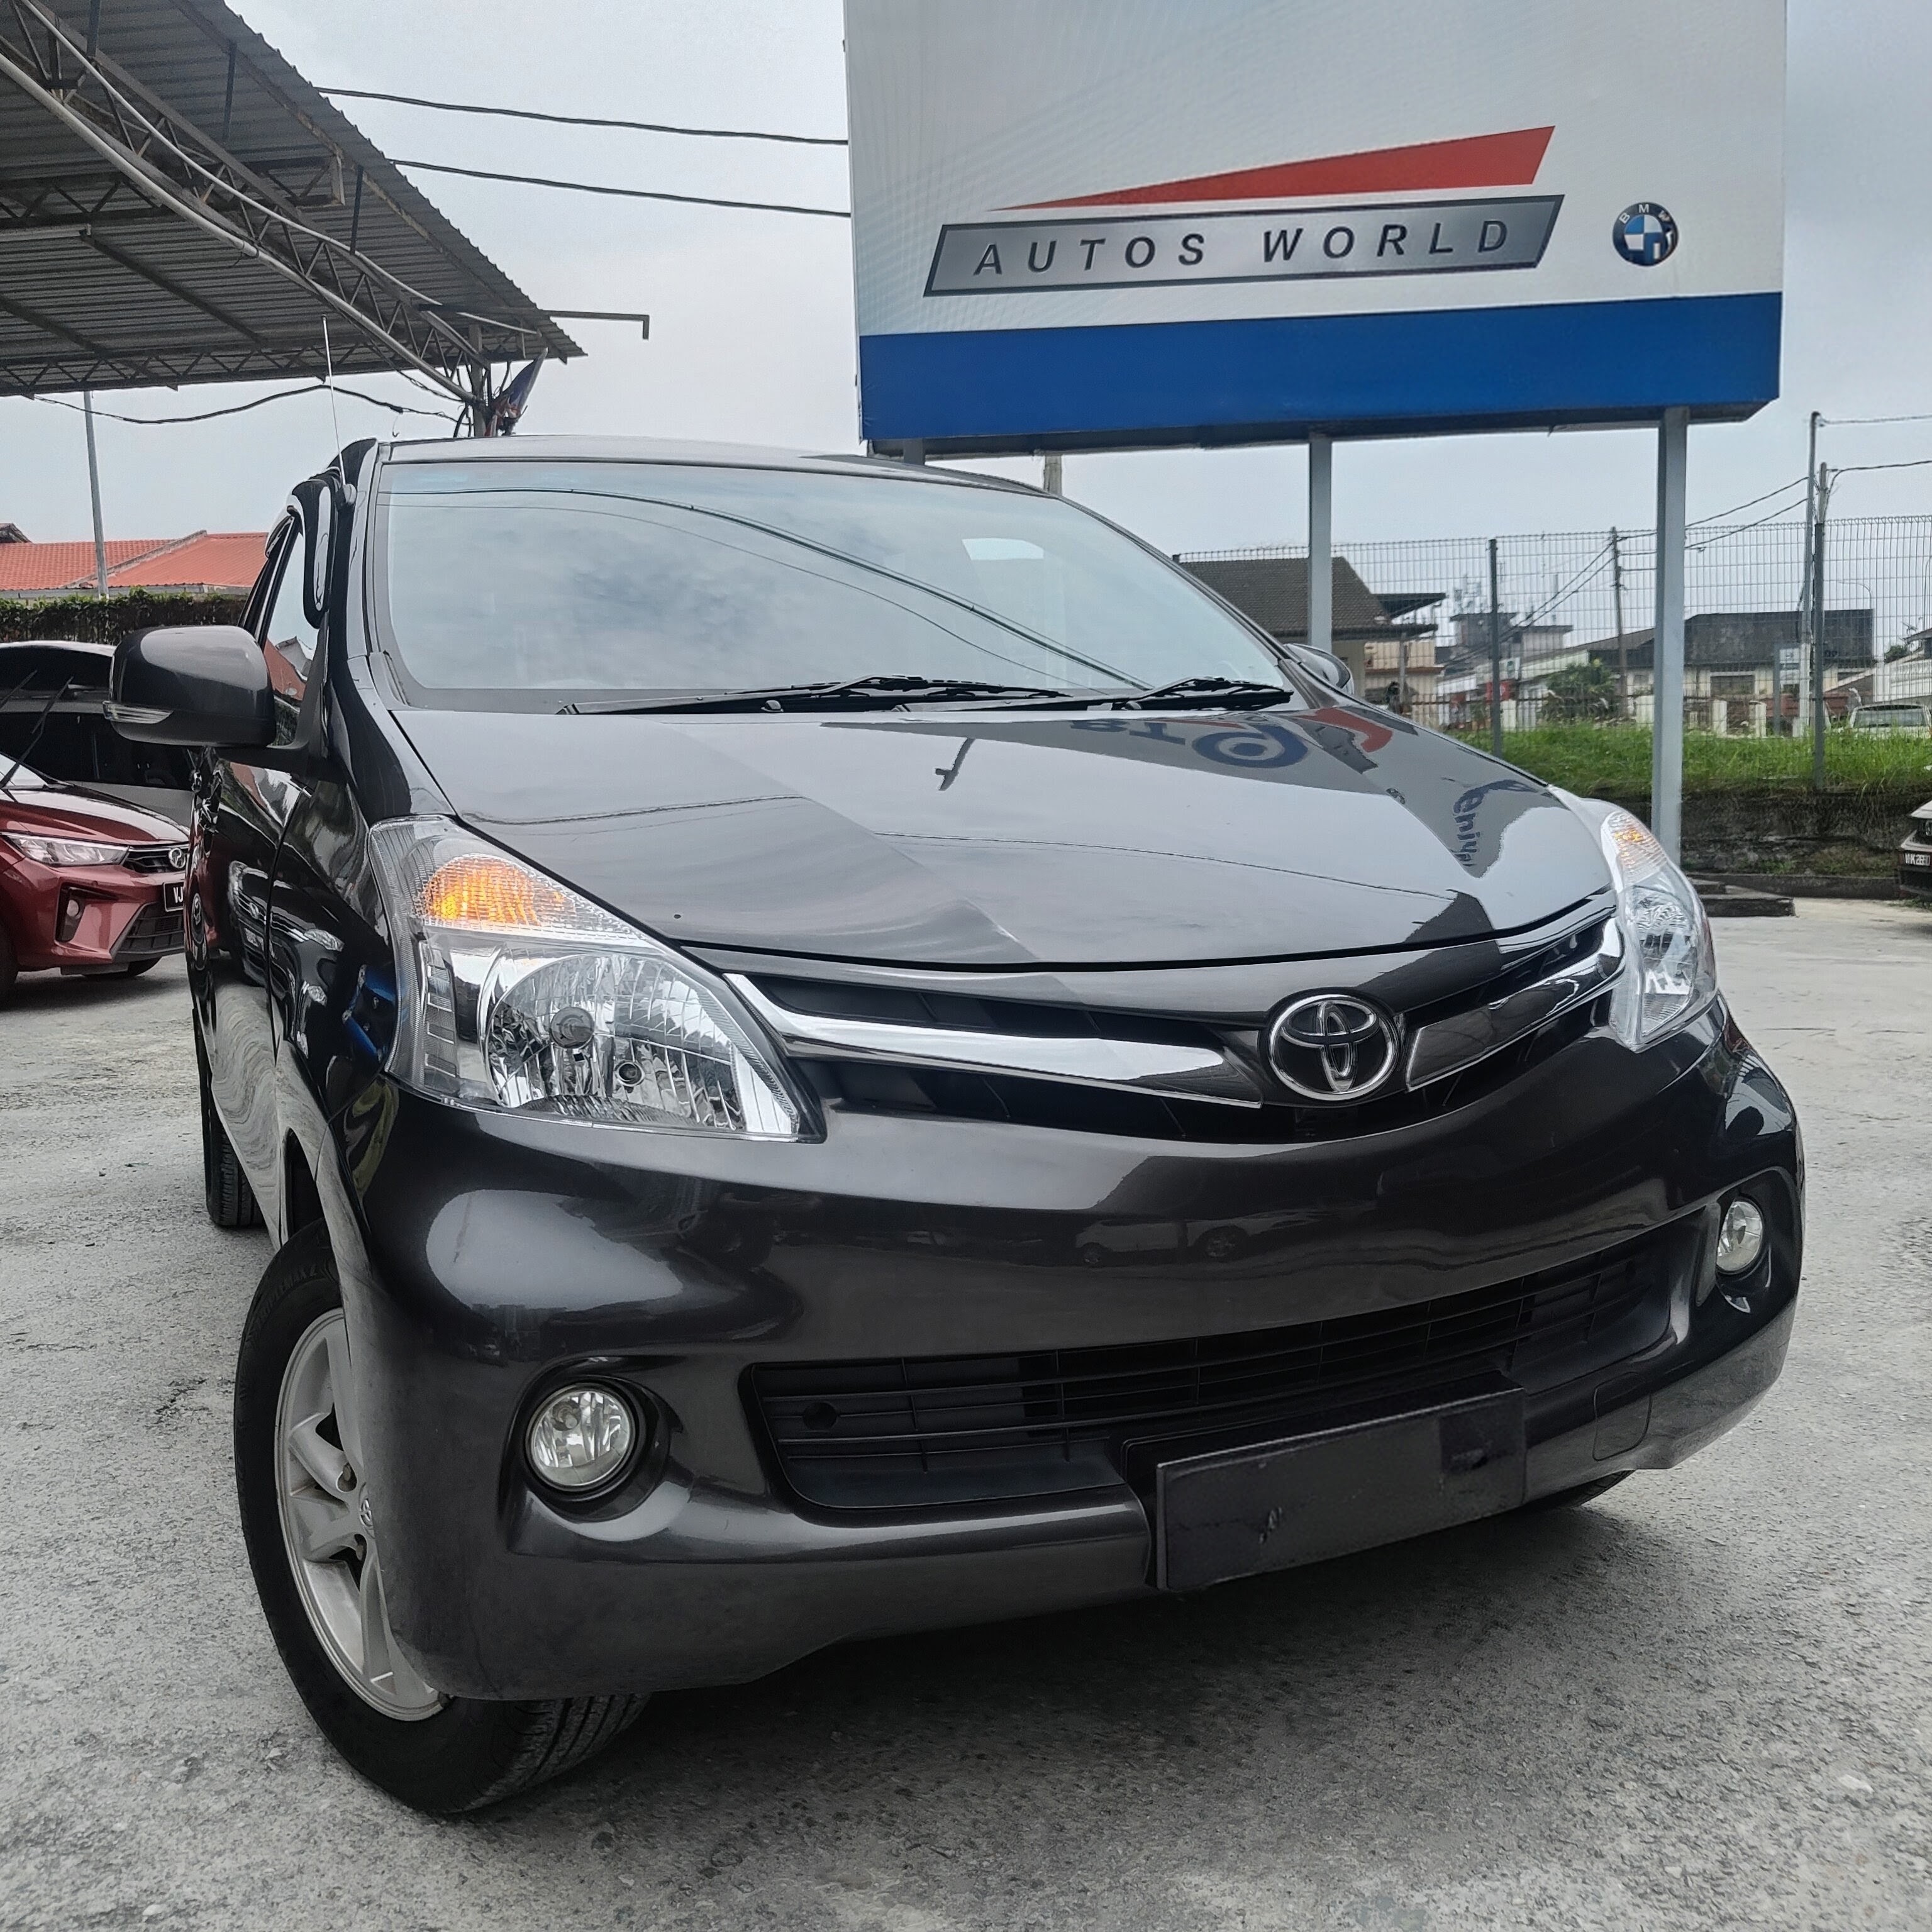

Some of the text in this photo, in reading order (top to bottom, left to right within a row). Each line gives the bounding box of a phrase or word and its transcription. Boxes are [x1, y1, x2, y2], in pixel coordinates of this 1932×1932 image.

[1619, 204, 1670, 224] BMW
[973, 220, 1508, 275] AUTOS WORLD
